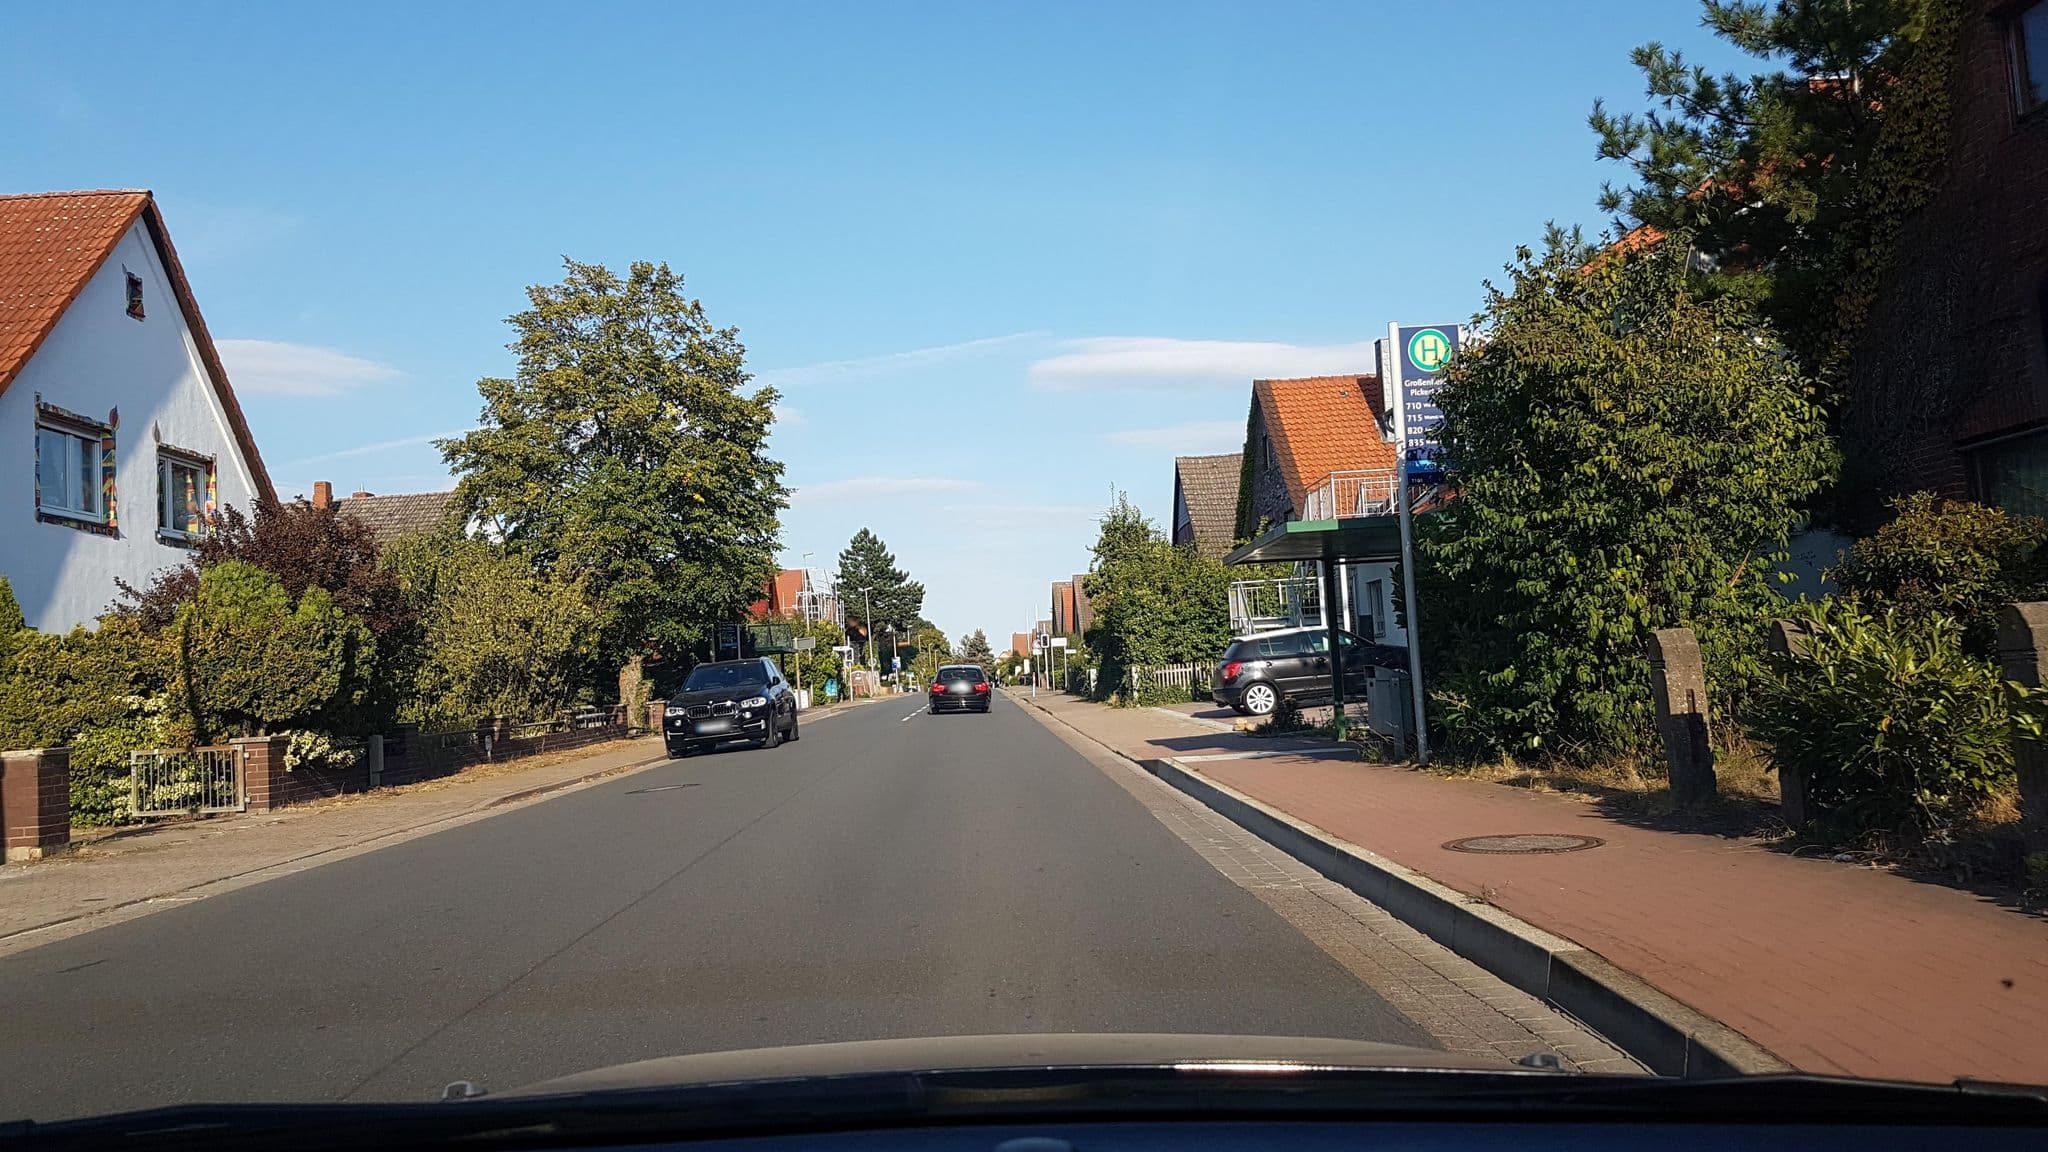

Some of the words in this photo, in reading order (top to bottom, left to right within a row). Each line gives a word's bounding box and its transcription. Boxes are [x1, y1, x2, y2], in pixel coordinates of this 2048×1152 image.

[1421, 338, 1438, 361] H
[1405, 402, 1422, 410] 710
[1406, 414, 1423, 422] 715
[1407, 426, 1424, 435] 820
[1408, 438, 1425, 447] 835
